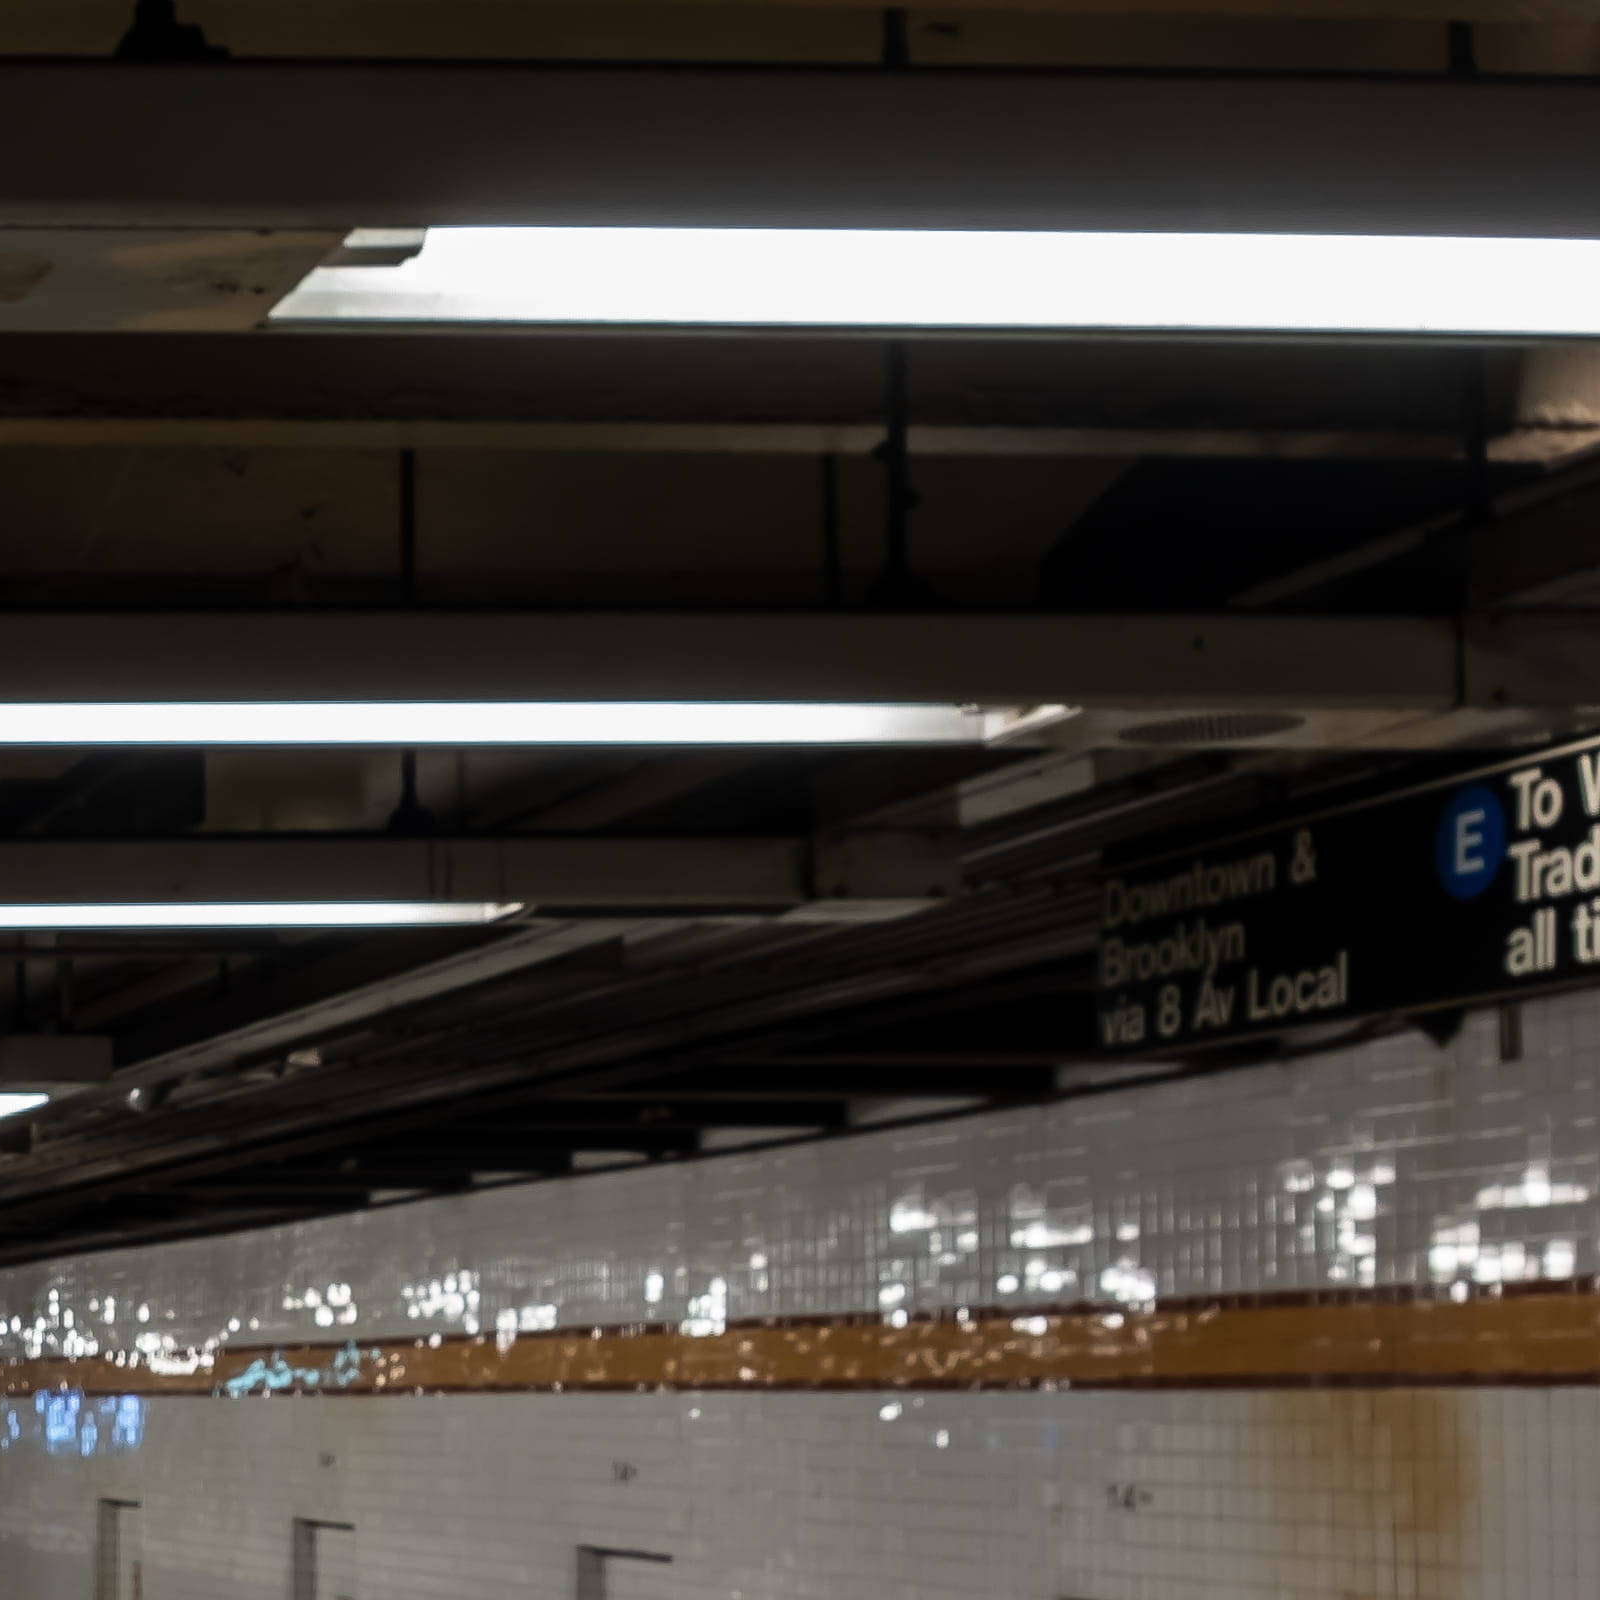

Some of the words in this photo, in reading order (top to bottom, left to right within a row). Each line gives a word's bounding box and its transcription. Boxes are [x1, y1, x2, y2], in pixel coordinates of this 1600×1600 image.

[1507, 767, 1563, 832] To
[1453, 807, 1485, 876] E
[1105, 850, 1277, 930] Downtown
[1289, 826, 1318, 886] &
[1102, 918, 1247, 988] Brooklyn
[1505, 906, 1556, 977] all
[1103, 993, 1146, 1046] via
[1155, 982, 1182, 1040] 8
[1192, 980, 1235, 1032] Av
[1246, 947, 1349, 1021] Local
